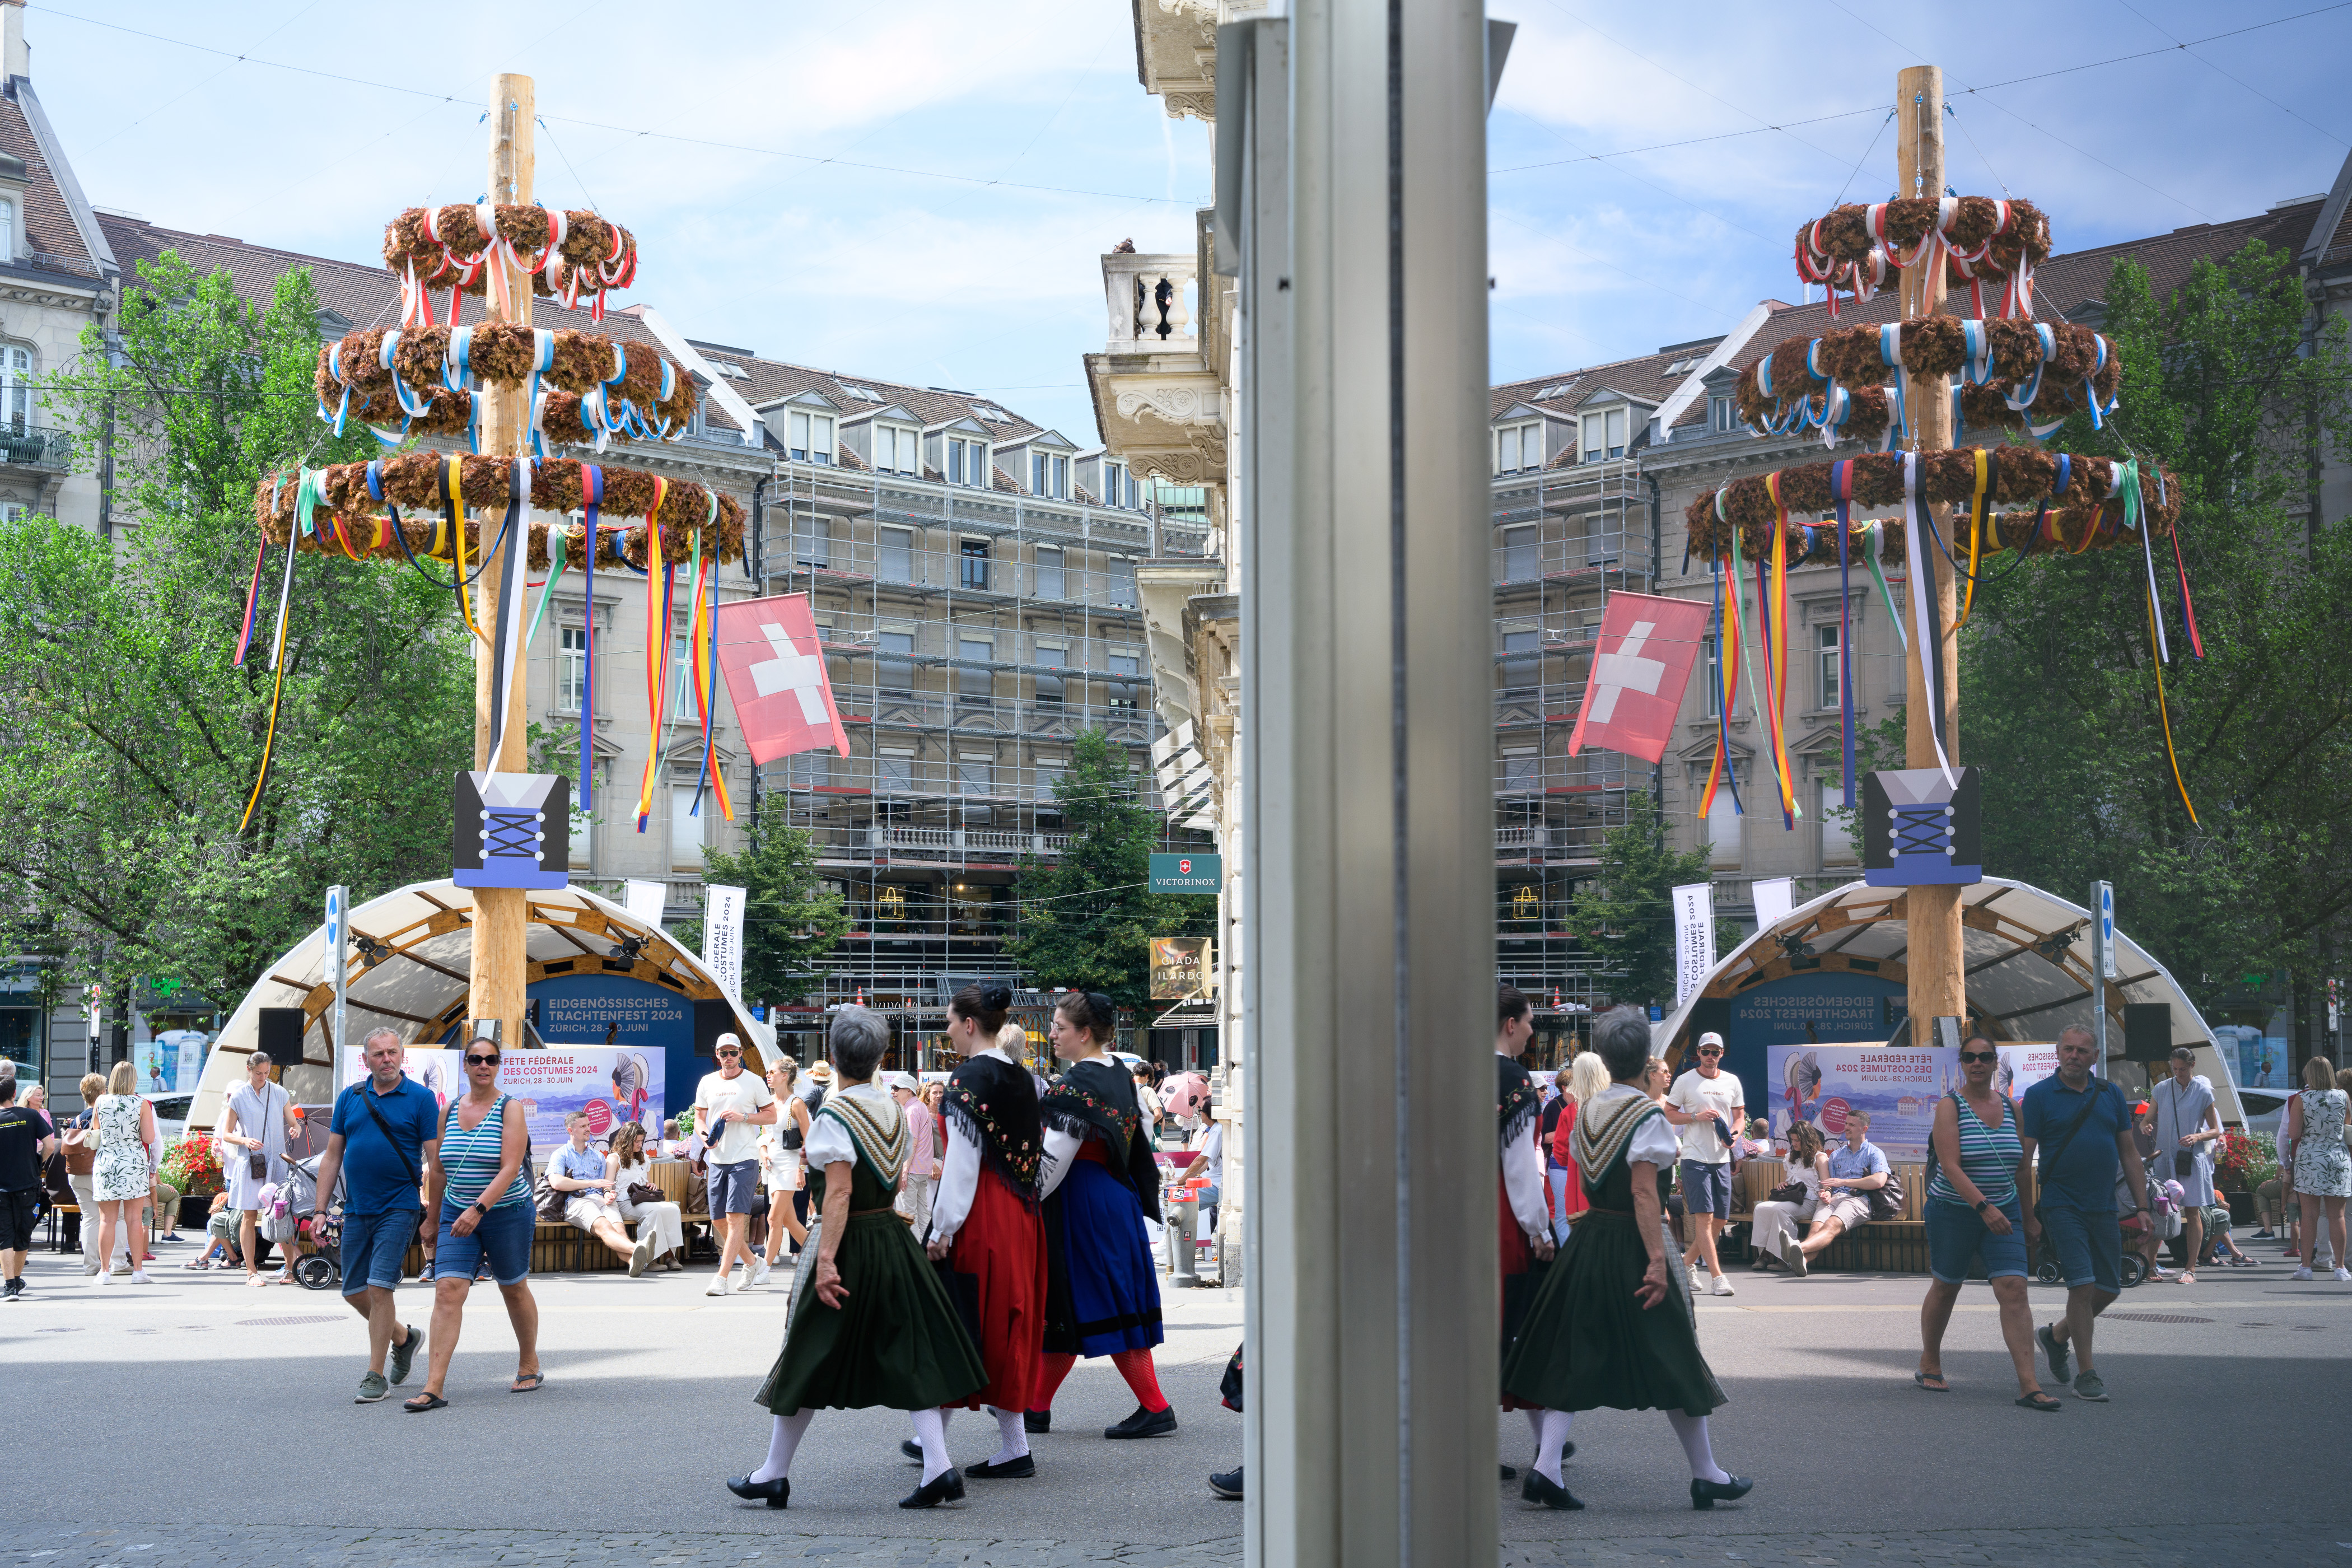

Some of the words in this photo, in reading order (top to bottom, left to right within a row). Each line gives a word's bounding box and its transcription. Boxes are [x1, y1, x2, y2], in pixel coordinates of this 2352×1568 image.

[1161, 956, 1200, 965] GIADA
[1158, 972, 1205, 980] ILARDO
[549, 997, 668, 1009] EIDGENÖSSISCHES
[549, 1011, 647, 1020] TRACHTENFEST
[651, 1010, 683, 1020] 2024
[549, 1023, 589, 1033] ZÜRICH,
[504, 1057, 525, 1065] FÊTE
[529, 1056, 573, 1065] FÉDÉRALE
[524, 1066, 573, 1075] COSTUMES
